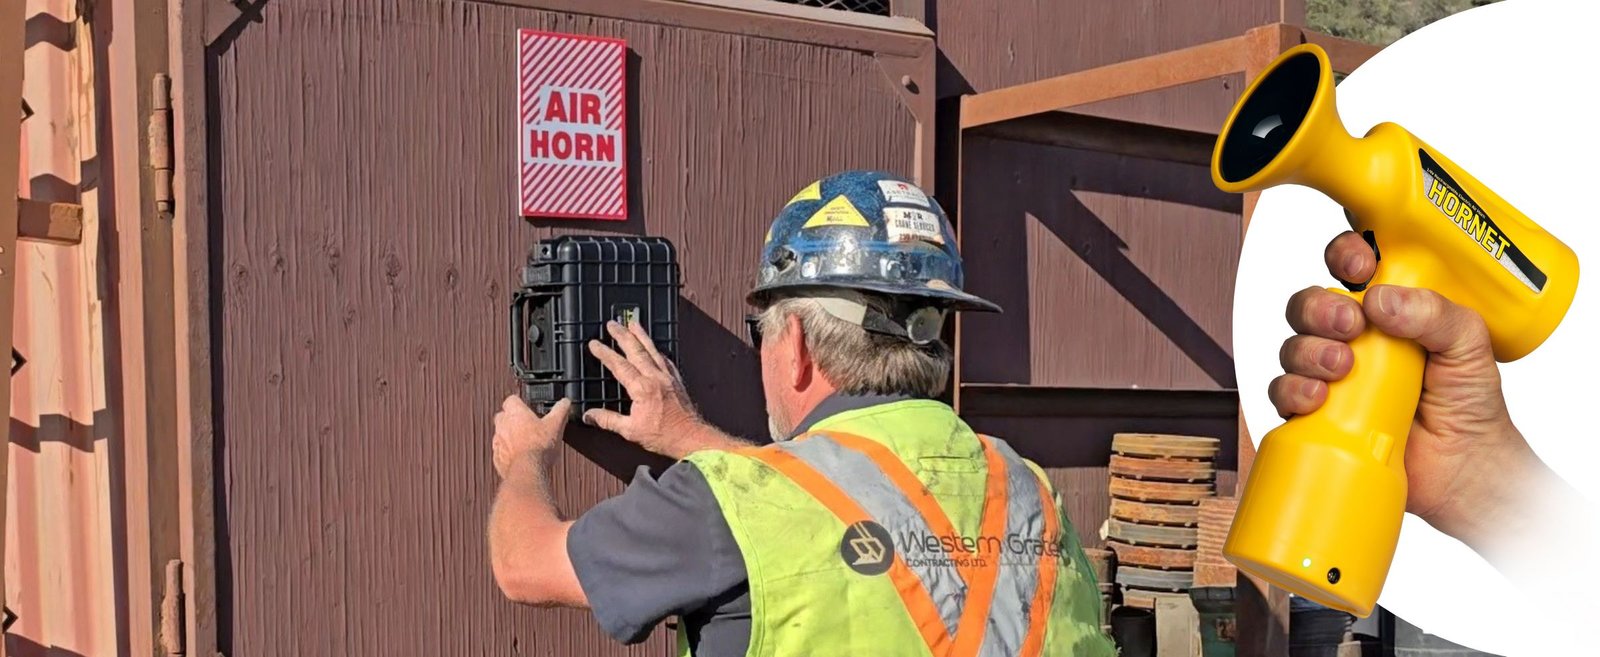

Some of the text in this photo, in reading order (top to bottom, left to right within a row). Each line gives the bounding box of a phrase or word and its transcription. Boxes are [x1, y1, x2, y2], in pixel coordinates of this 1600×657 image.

[544, 91, 601, 125] AIR
[530, 129, 615, 162] HORN
[1428, 178, 1511, 260] HORNET
[900, 530, 1003, 555] Western
[905, 558, 970, 568] CONTRACTING
